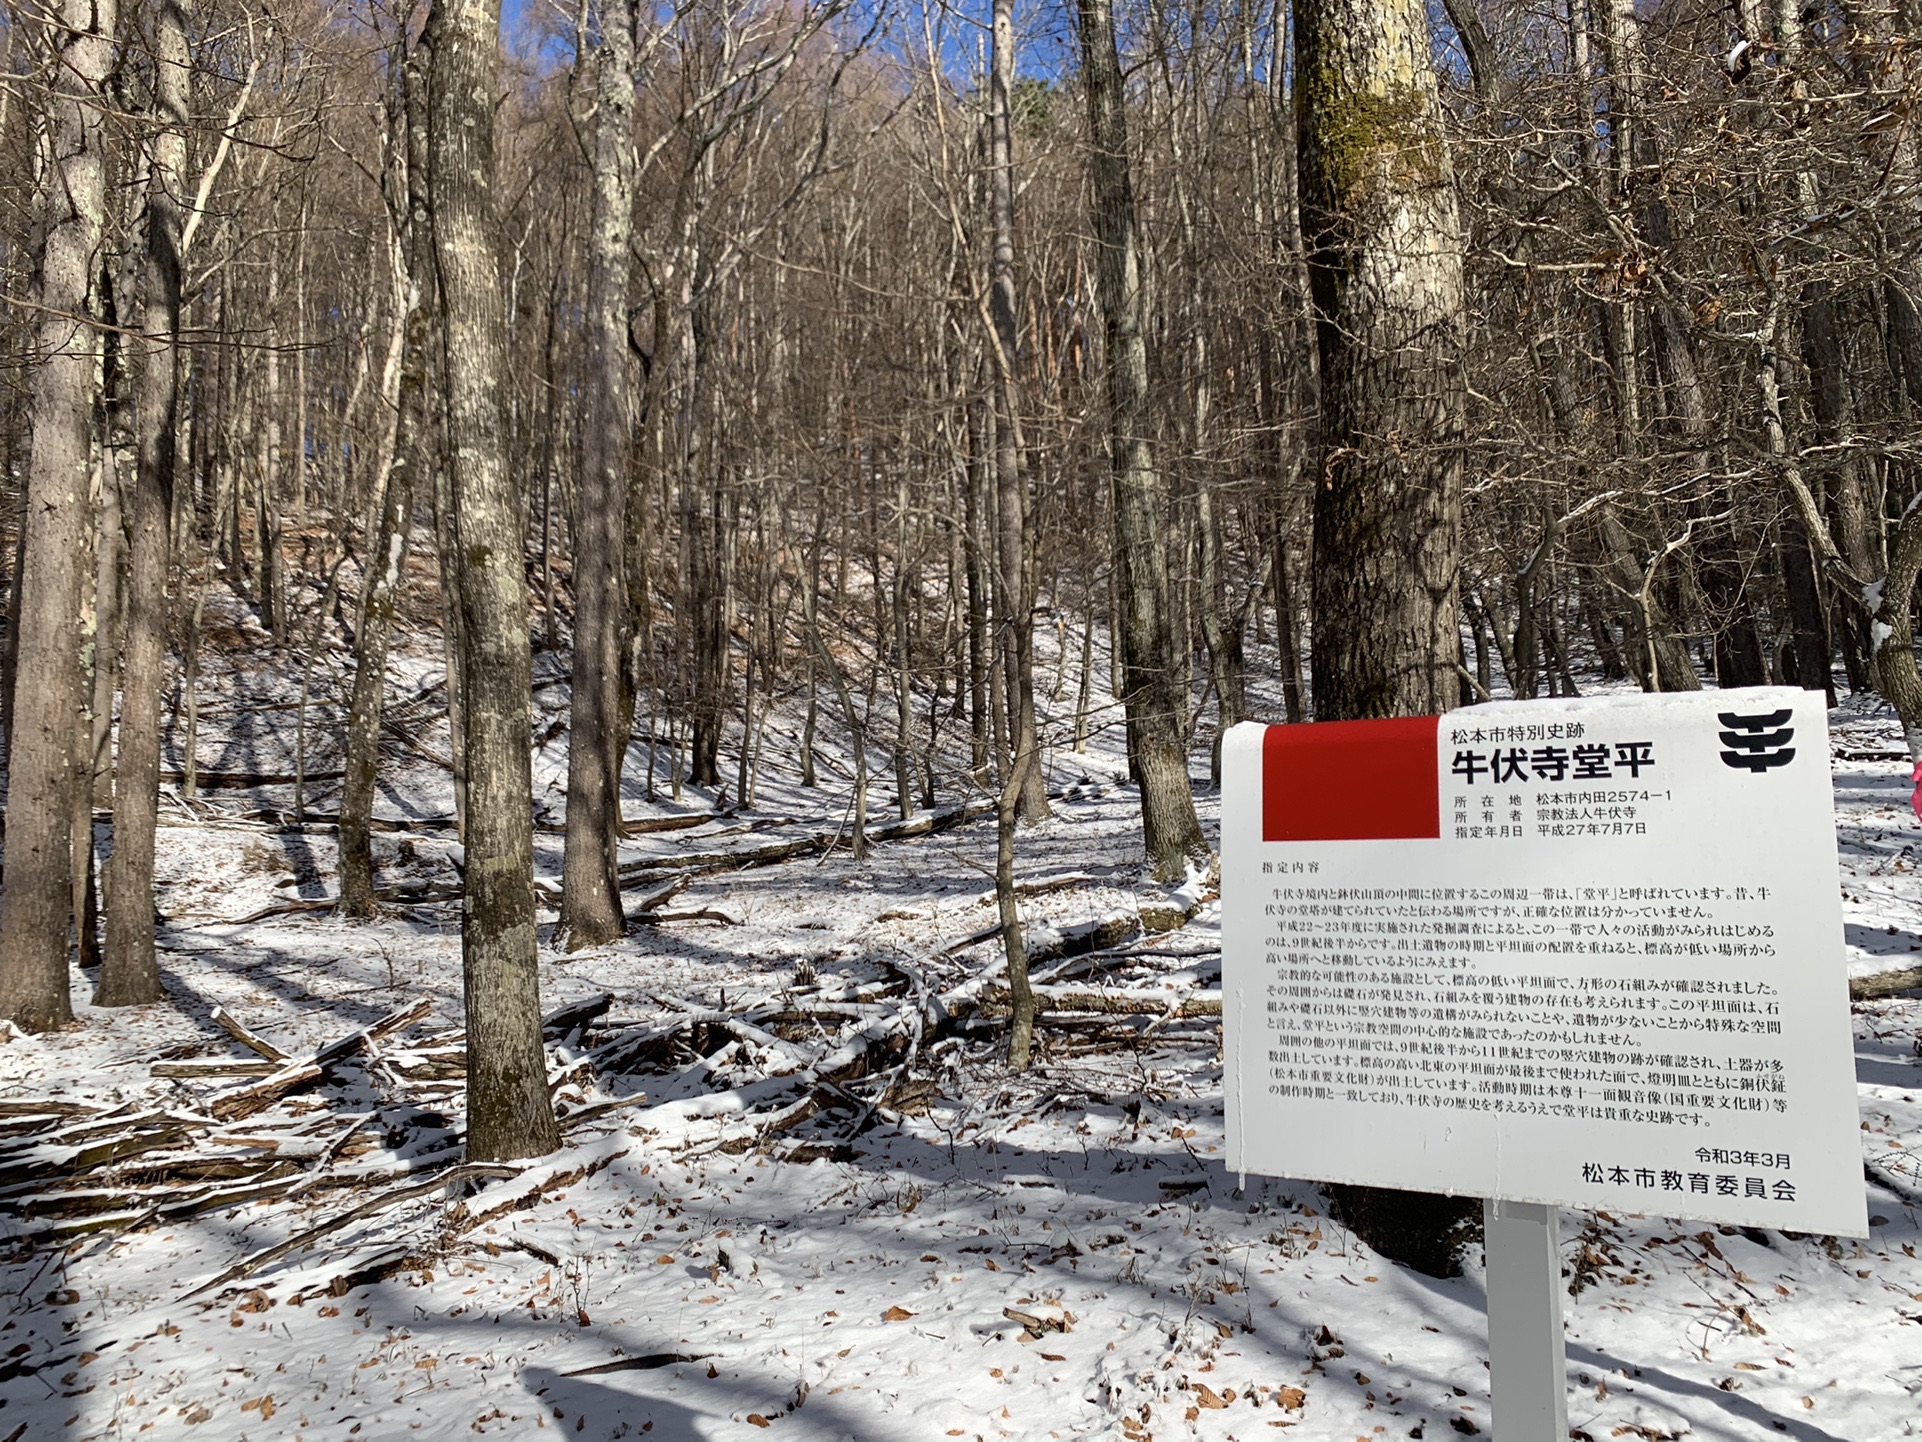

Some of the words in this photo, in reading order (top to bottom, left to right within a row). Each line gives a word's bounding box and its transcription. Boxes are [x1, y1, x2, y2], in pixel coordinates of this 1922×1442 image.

[1450, 722, 1585, 745] 松本市特別史跡
[1451, 741, 1655, 785] 牛伏寺堂平
[1536, 806, 1637, 822] 宗教法人牛伏寺
[1455, 825, 1523, 840] 指定年月日
[1537, 822, 1647, 838] 平成27年7月7日
[1262, 861, 1320, 874] 指定内容
[1694, 1147, 1791, 1170] 令和3年3月
[1582, 1162, 1797, 1202] 松本市教育委員会
